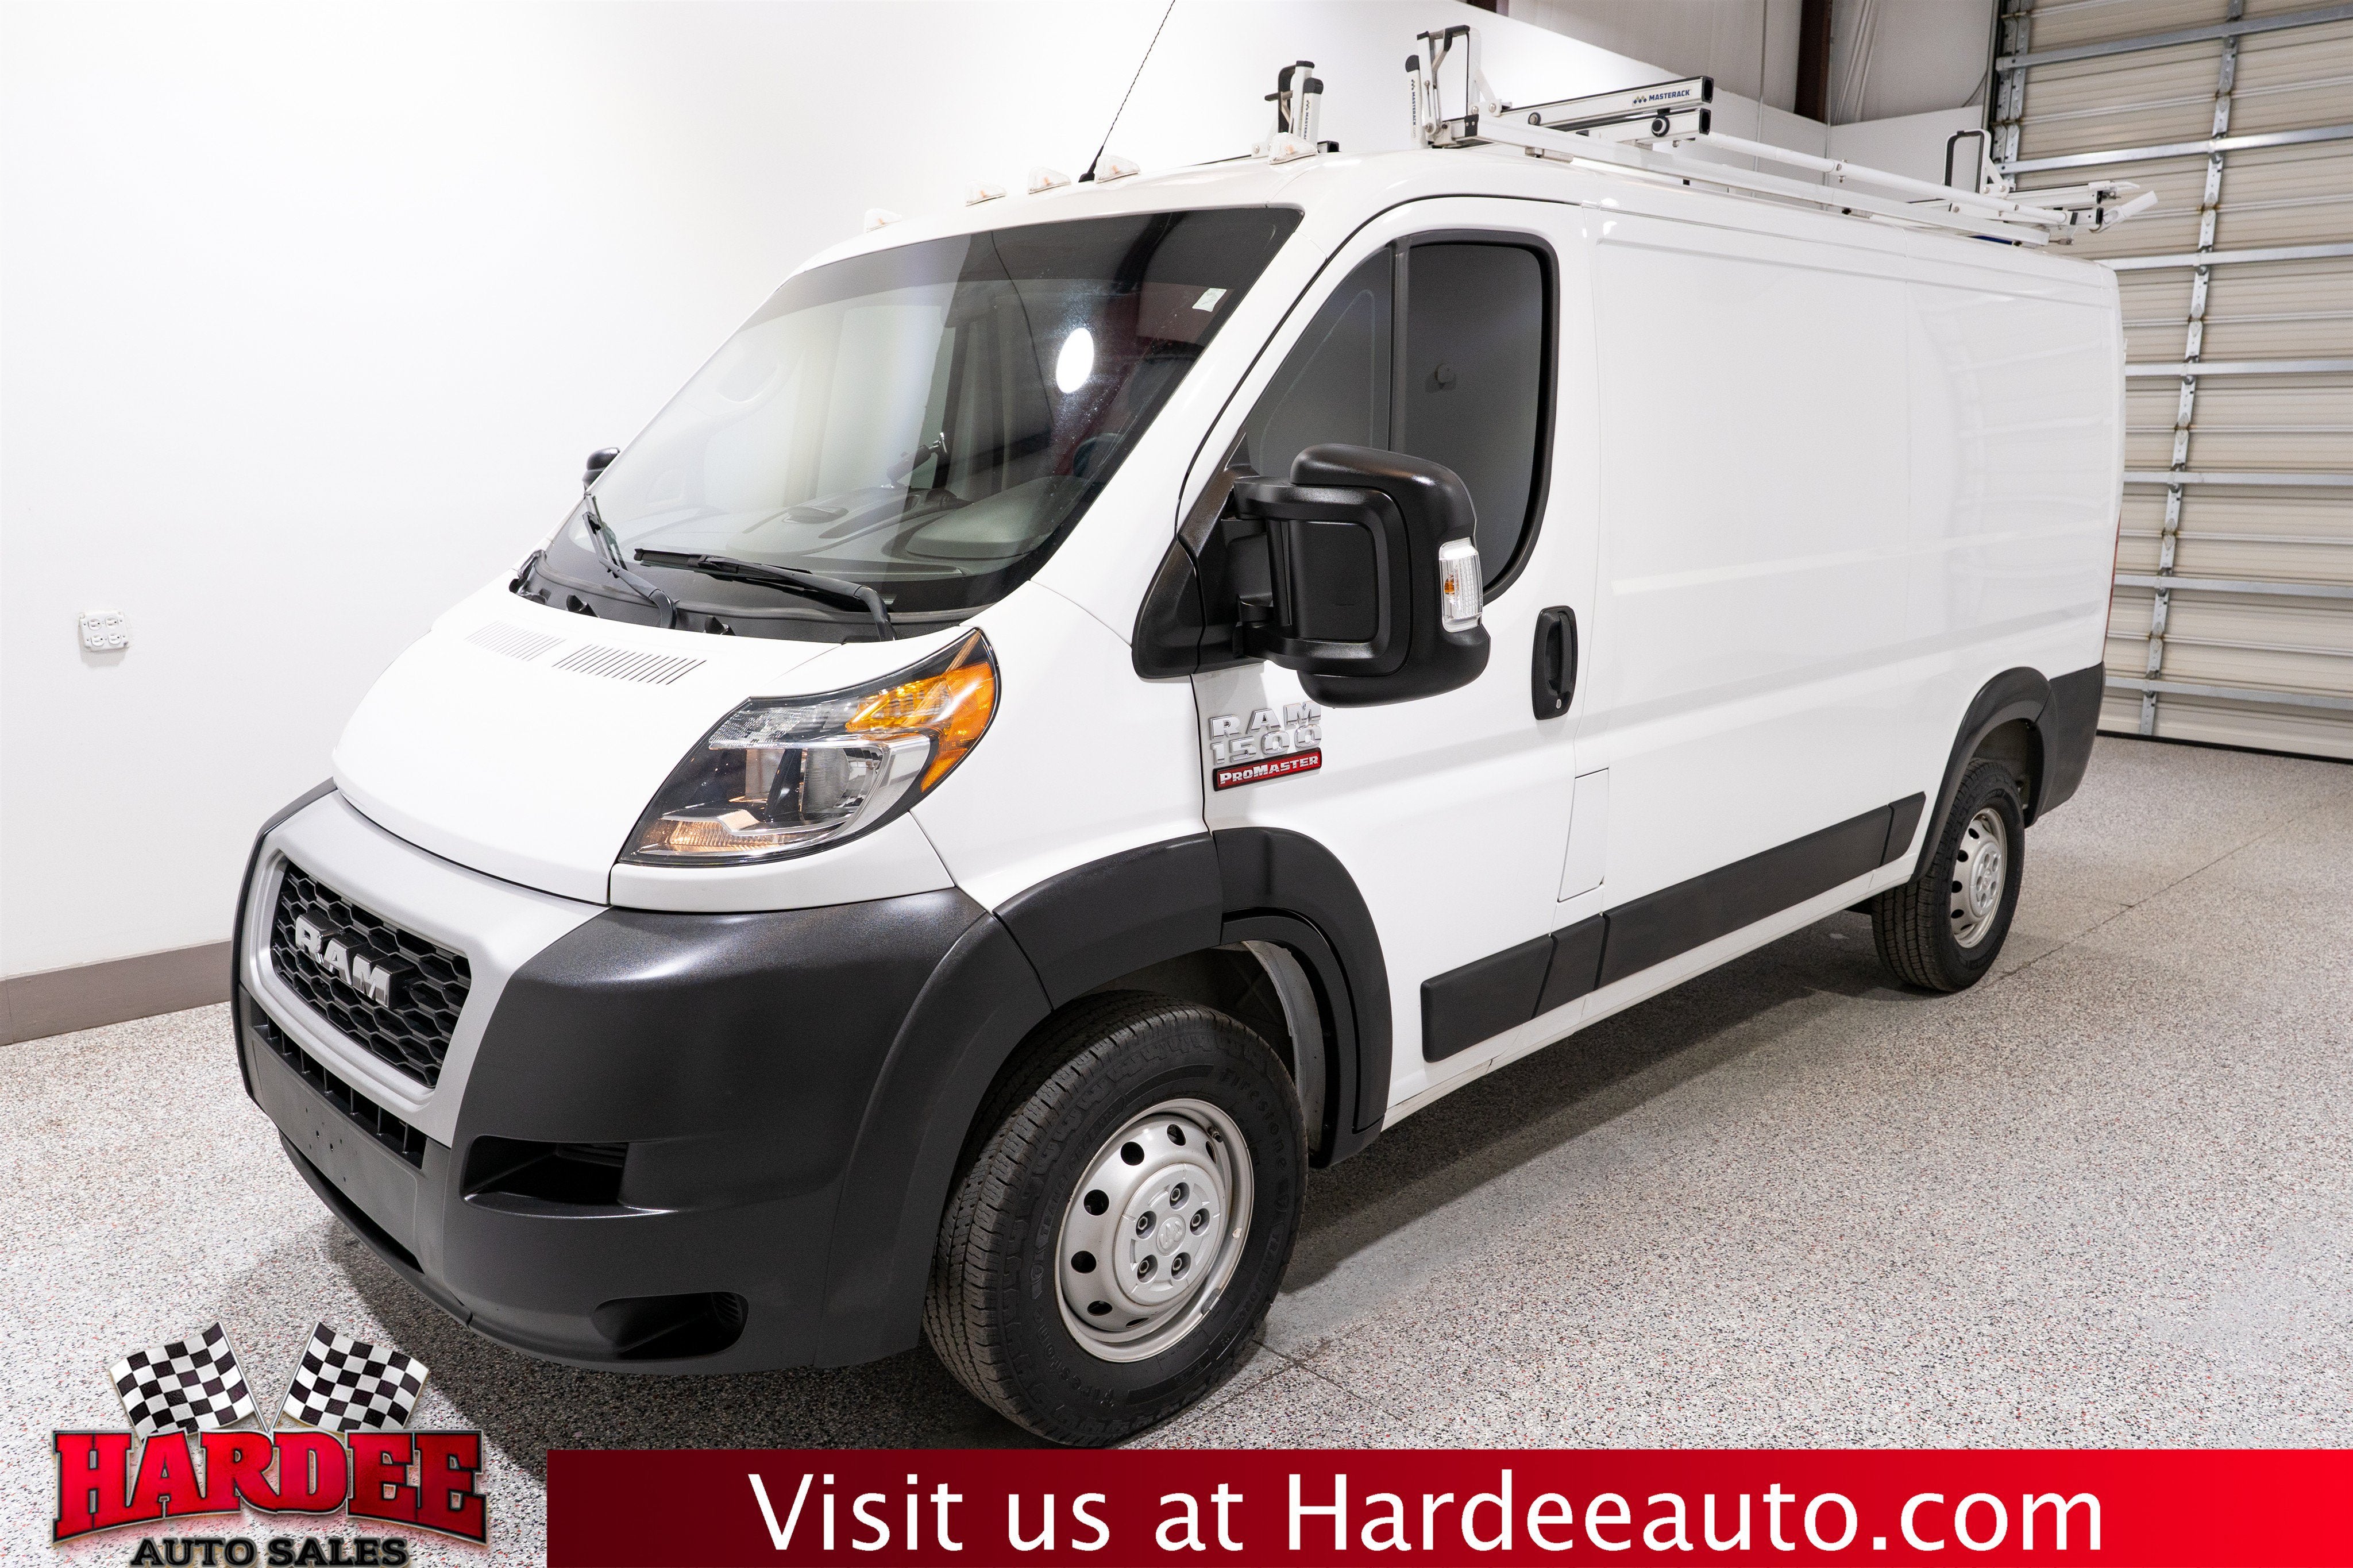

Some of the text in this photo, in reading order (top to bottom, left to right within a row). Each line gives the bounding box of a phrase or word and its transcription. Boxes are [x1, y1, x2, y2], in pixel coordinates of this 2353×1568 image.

[1649, 89, 1690, 101] MASTERACK
[1209, 700, 1321, 740] RAM
[1210, 725, 1321, 765] 1500
[295, 914, 392, 1008] RAM
